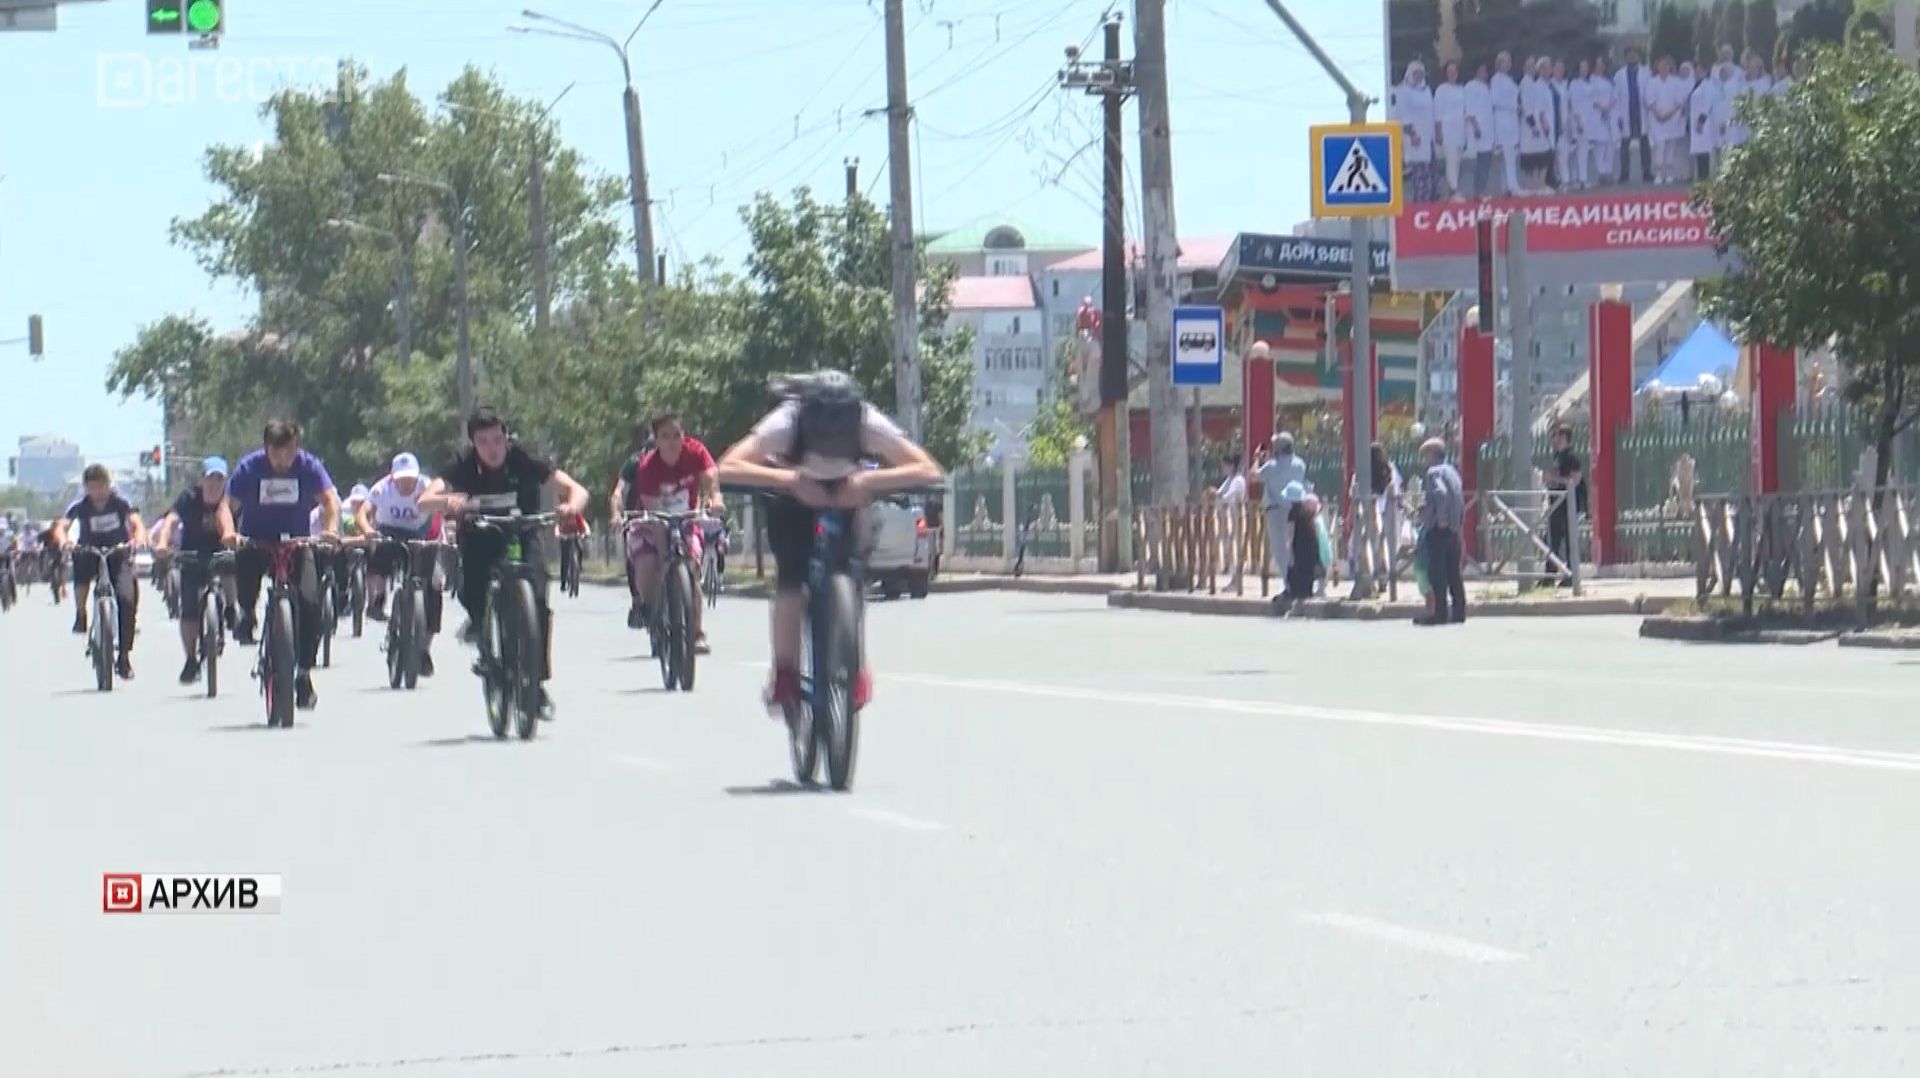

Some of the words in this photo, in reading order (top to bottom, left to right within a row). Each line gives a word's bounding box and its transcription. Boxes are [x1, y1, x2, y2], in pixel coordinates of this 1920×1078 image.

[1414, 211, 1430, 230] С
[1523, 201, 1713, 229] МЕДИЦИНСКО
[1606, 228, 1698, 245] СПАСИБО
